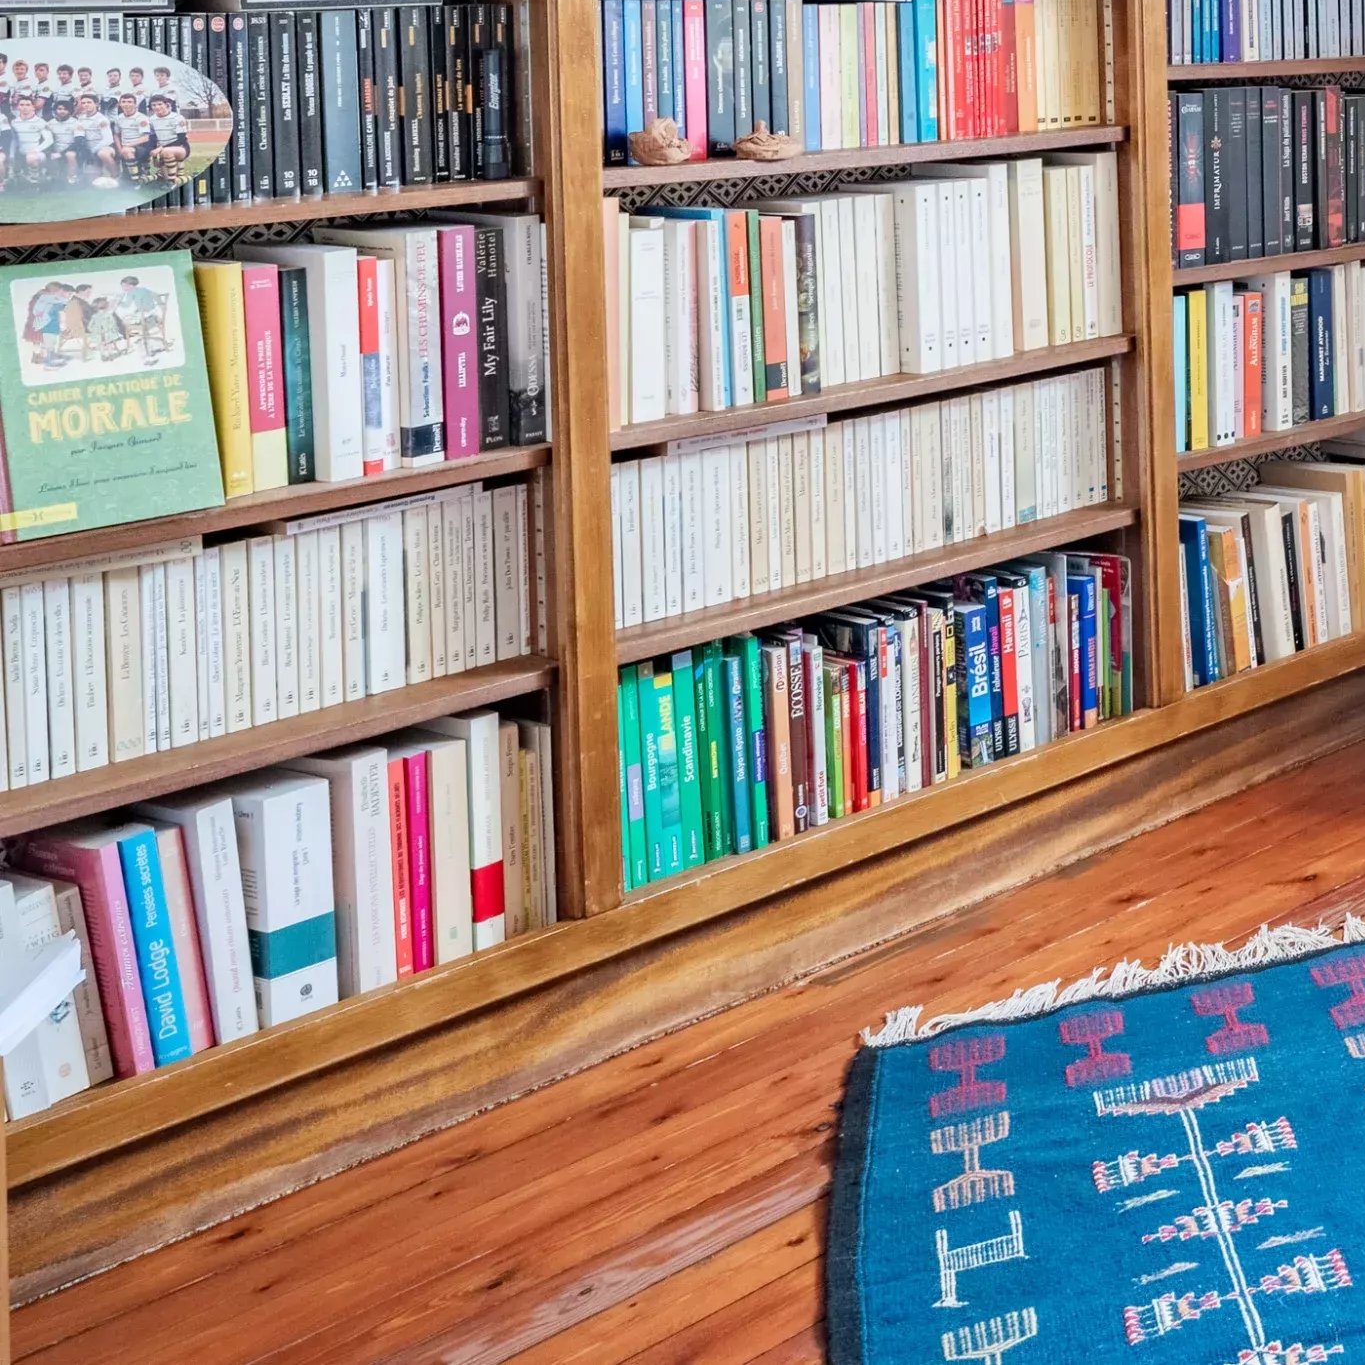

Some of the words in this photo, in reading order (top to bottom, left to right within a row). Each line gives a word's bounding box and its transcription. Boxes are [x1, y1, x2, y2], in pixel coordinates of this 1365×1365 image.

[256, 62, 265, 75] des
[282, 82, 292, 110] SEDLEY
[488, 73, 501, 110] Energizer
[386, 97, 397, 122] chapelet
[1299, 105, 1307, 128] FEMMES
[258, 126, 269, 151] Chester
[1282, 119, 1292, 138] patient
[1282, 146, 1292, 160] Saga
[1213, 150, 1223, 210] IMPRIMATUR
[1300, 162, 1308, 184] BOSTON
[413, 242, 425, 264] FEU
[476, 233, 488, 274] Valérie
[486, 231, 498, 278] Hanotel
[805, 244, 815, 277] Augustus
[1085, 244, 1094, 280] PROTOCOLE
[413, 265, 425, 283] DE
[1087, 280, 1095, 288] LE
[807, 278, 817, 304] Semper
[414, 283, 429, 338] CHEMINS
[481, 296, 498, 323] Lily
[483, 325, 497, 351] Fair
[1231, 322, 1240, 372] ALLINGHAM
[1249, 317, 1259, 367] ALLINGHAM
[1317, 315, 1325, 346] ATWOOD
[416, 338, 429, 359] LES
[484, 353, 500, 377] My
[1318, 346, 1326, 382] MARGARET
[421, 361, 430, 384] Faulks
[28, 387, 81, 406] CAHIER
[87, 377, 158, 399] PRATIQUE
[162, 374, 183, 388] DE
[422, 385, 432, 418] Sebastian
[29, 391, 192, 444] MORALE
[431, 423, 444, 452] Denoël
[1201, 565, 1211, 600] responsable
[989, 625, 1000, 656] Hawaii
[1000, 613, 1014, 654] Hawaii
[1016, 622, 1029, 659] PARIS
[969, 642, 989, 699] Brésil
[990, 656, 1001, 693] Fabuleuse
[1087, 636, 1096, 690] NORMANDIE
[789, 664, 804, 718] ECOSSE
[813, 675, 825, 711] Norvège
[908, 656, 920, 715] LONDRES
[682, 715, 695, 783] Scandinavie
[734, 727, 745, 752] Kyoto
[993, 720, 1004, 753] ULYSSE
[1006, 716, 1018, 752] ULYSSE
[645, 732, 659, 792] Bourgogne
[734, 757, 746, 782] Tokyo
[779, 742, 790, 775] Québec
[814, 770, 825, 788] futé
[816, 788, 827, 808] petit
[134, 844, 152, 887] secrètes
[142, 887, 158, 928] Pensées
[146, 938, 171, 991] Lodge
[153, 992, 179, 1040] David
